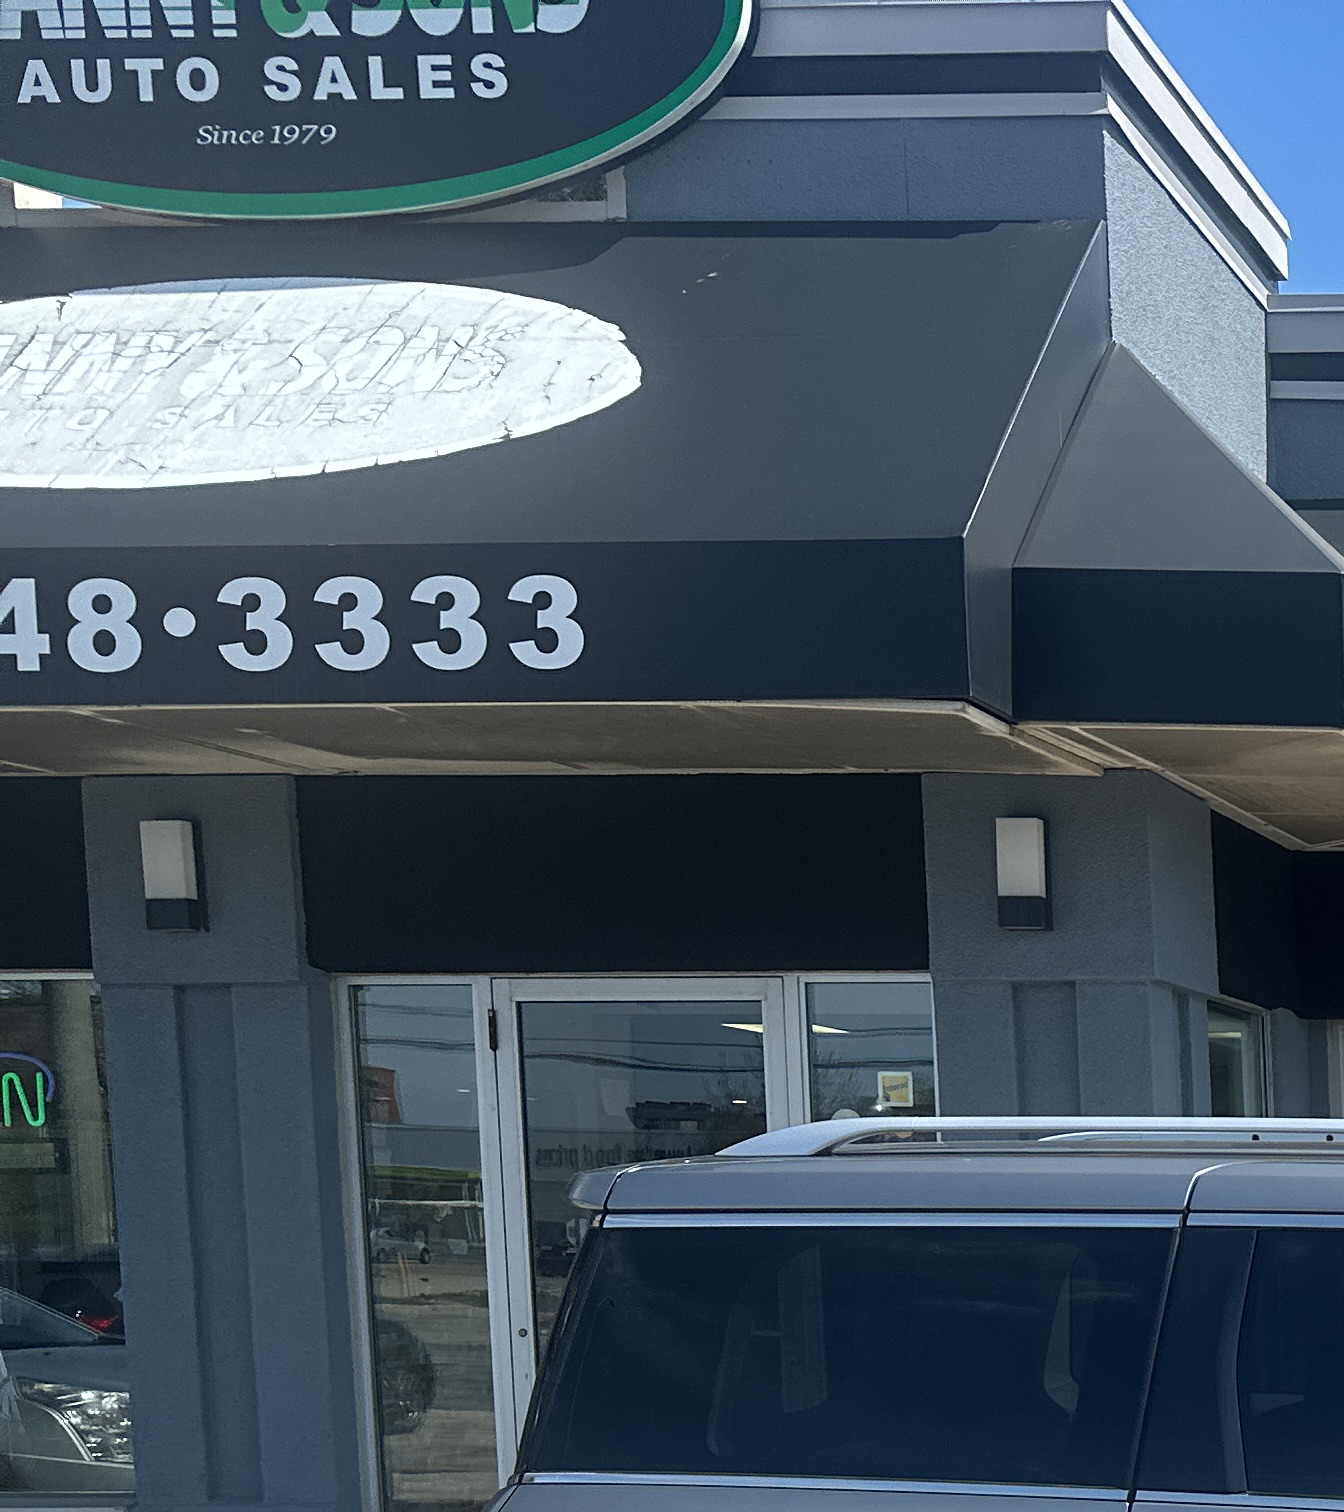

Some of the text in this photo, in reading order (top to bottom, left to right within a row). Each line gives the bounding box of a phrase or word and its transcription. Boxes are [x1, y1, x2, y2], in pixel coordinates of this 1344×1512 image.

[17, 52, 509, 103] AUTO SALES
[196, 124, 337, 146] Since 1979
